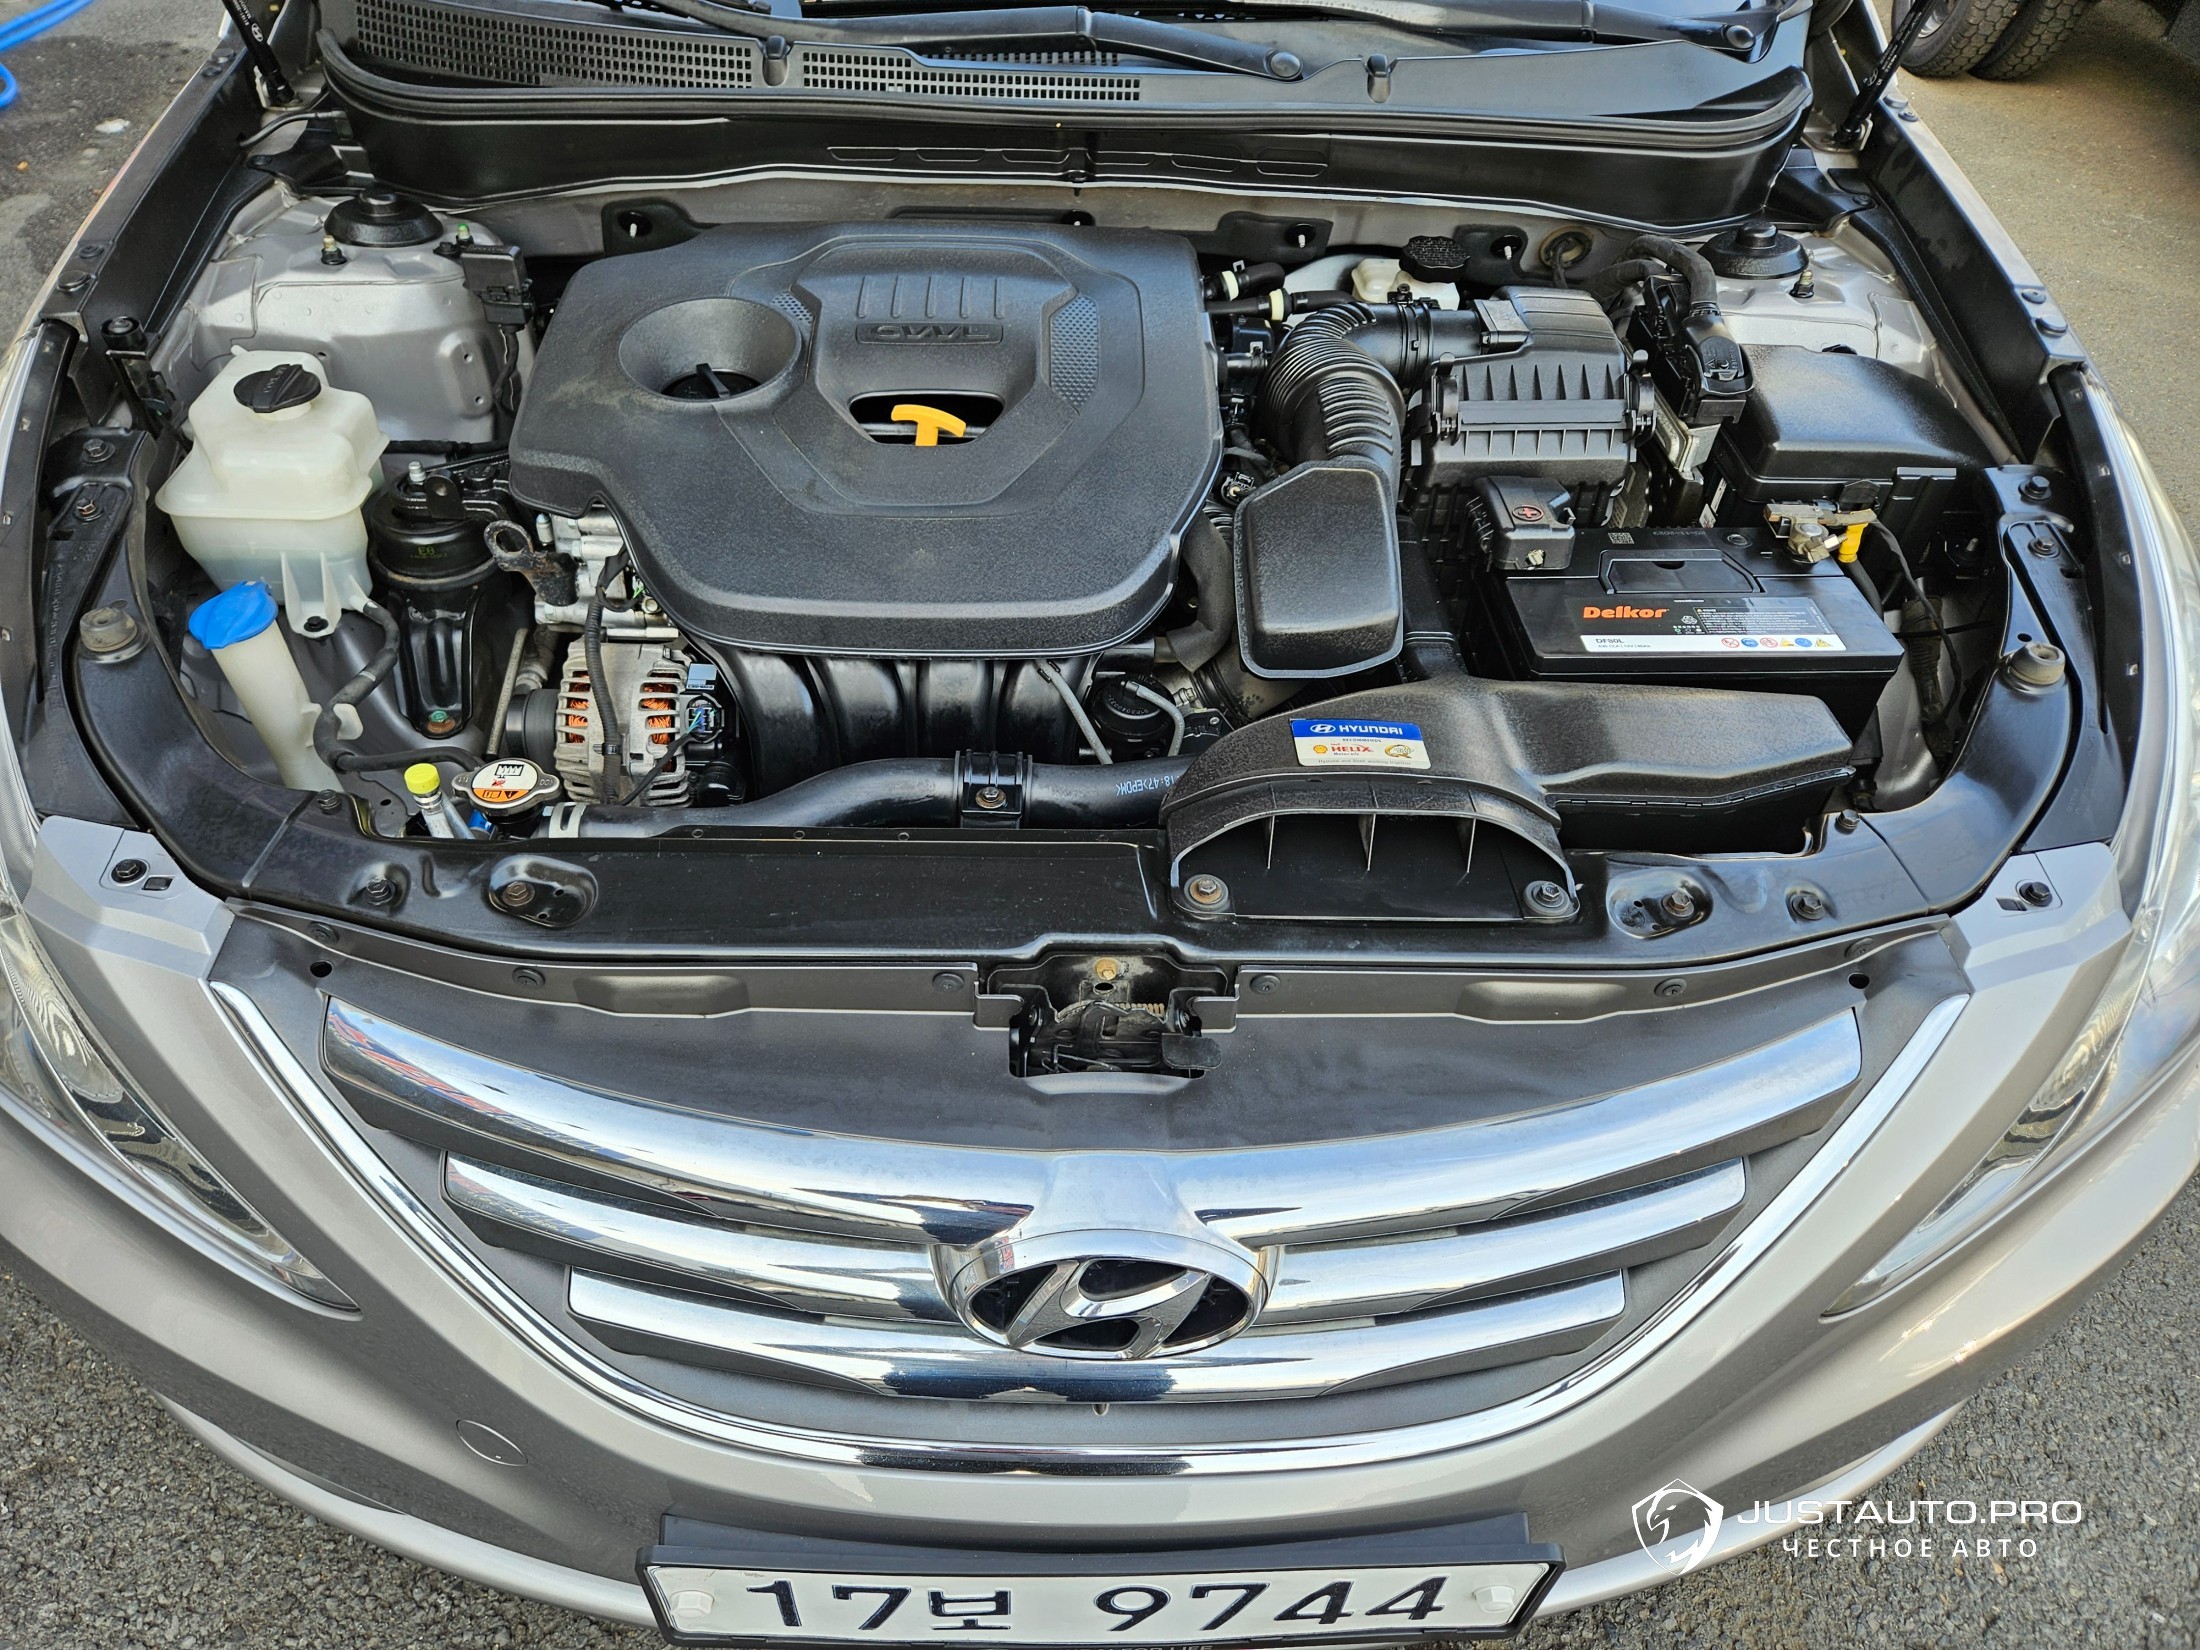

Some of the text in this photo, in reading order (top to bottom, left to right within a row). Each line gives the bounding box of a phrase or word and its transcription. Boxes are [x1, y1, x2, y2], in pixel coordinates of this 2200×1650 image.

[1582, 605, 1669, 620] Delkor
[1339, 724, 1403, 735] HYUNDAI
[1331, 745, 1373, 753] HELIX
[745, 1575, 1447, 1633] 17보 9744
